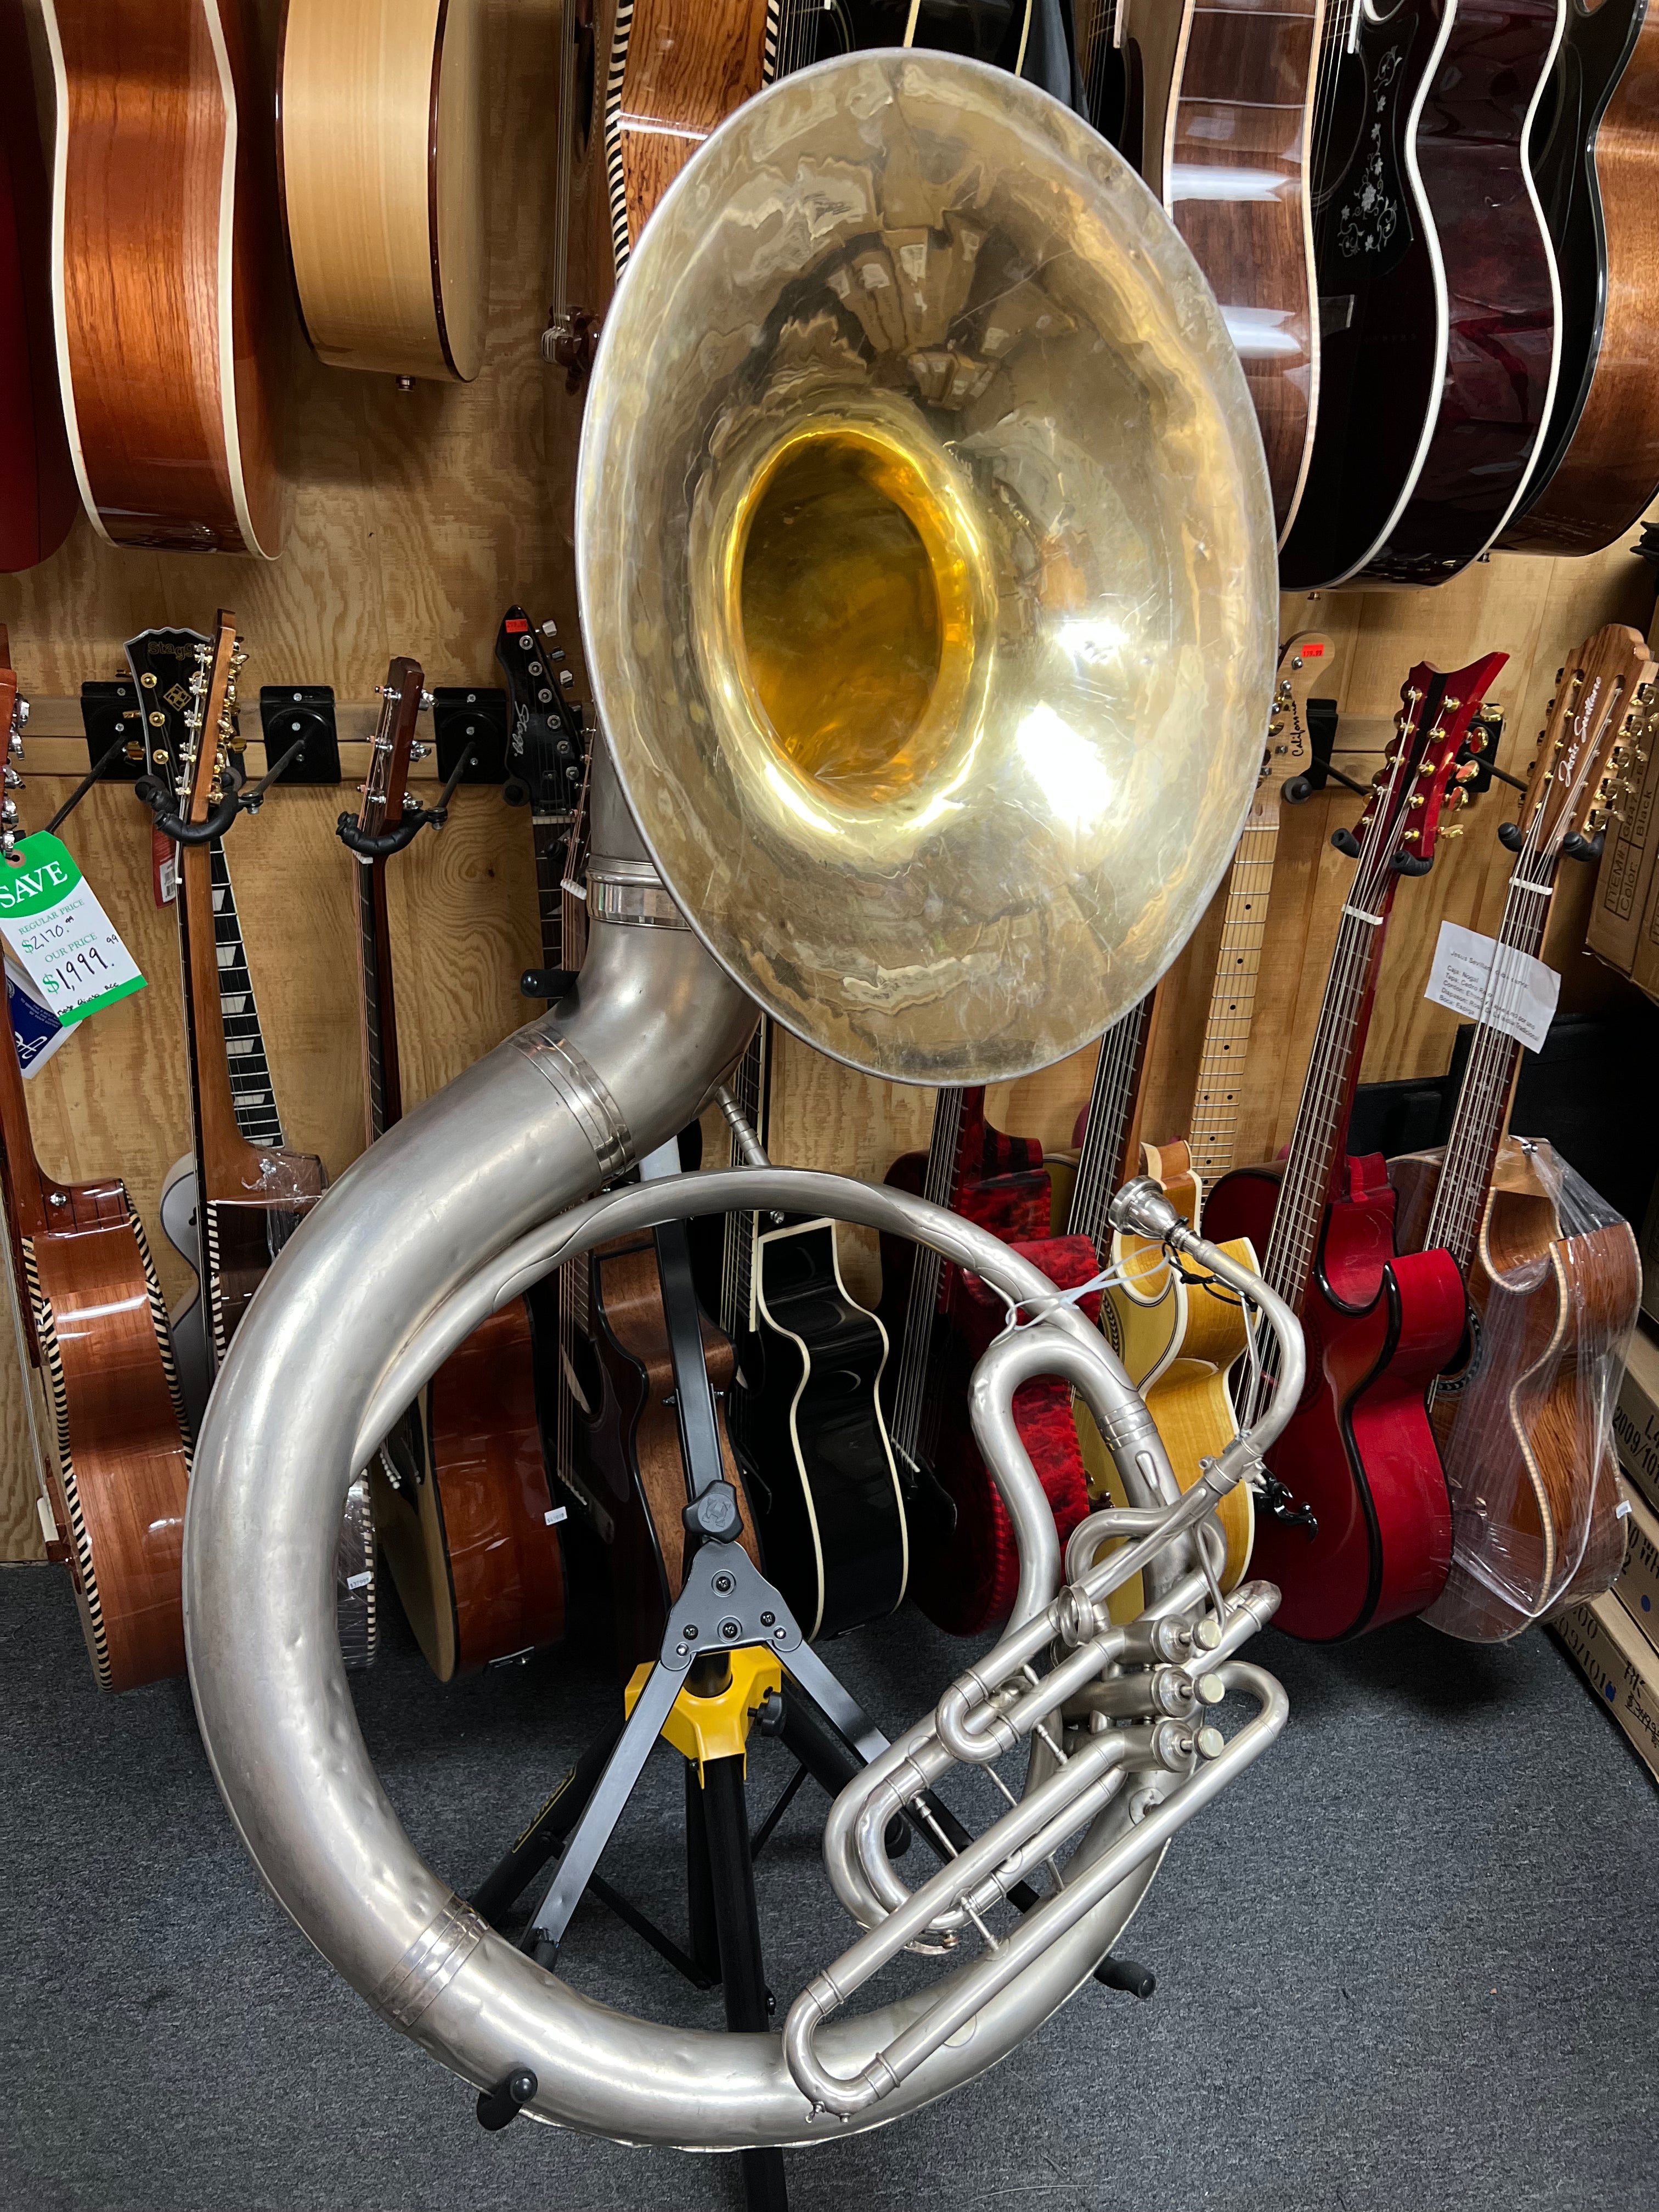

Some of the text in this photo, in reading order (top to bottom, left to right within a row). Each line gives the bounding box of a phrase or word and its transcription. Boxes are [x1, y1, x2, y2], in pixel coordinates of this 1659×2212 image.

[148, 641, 196, 660] Stagg
[1636, 789, 1653, 837] Black
[0, 861, 68, 909] SAVE
[19, 899, 85, 935] REGULAR PRICE
[45, 933, 98, 963] OUR PRICE
